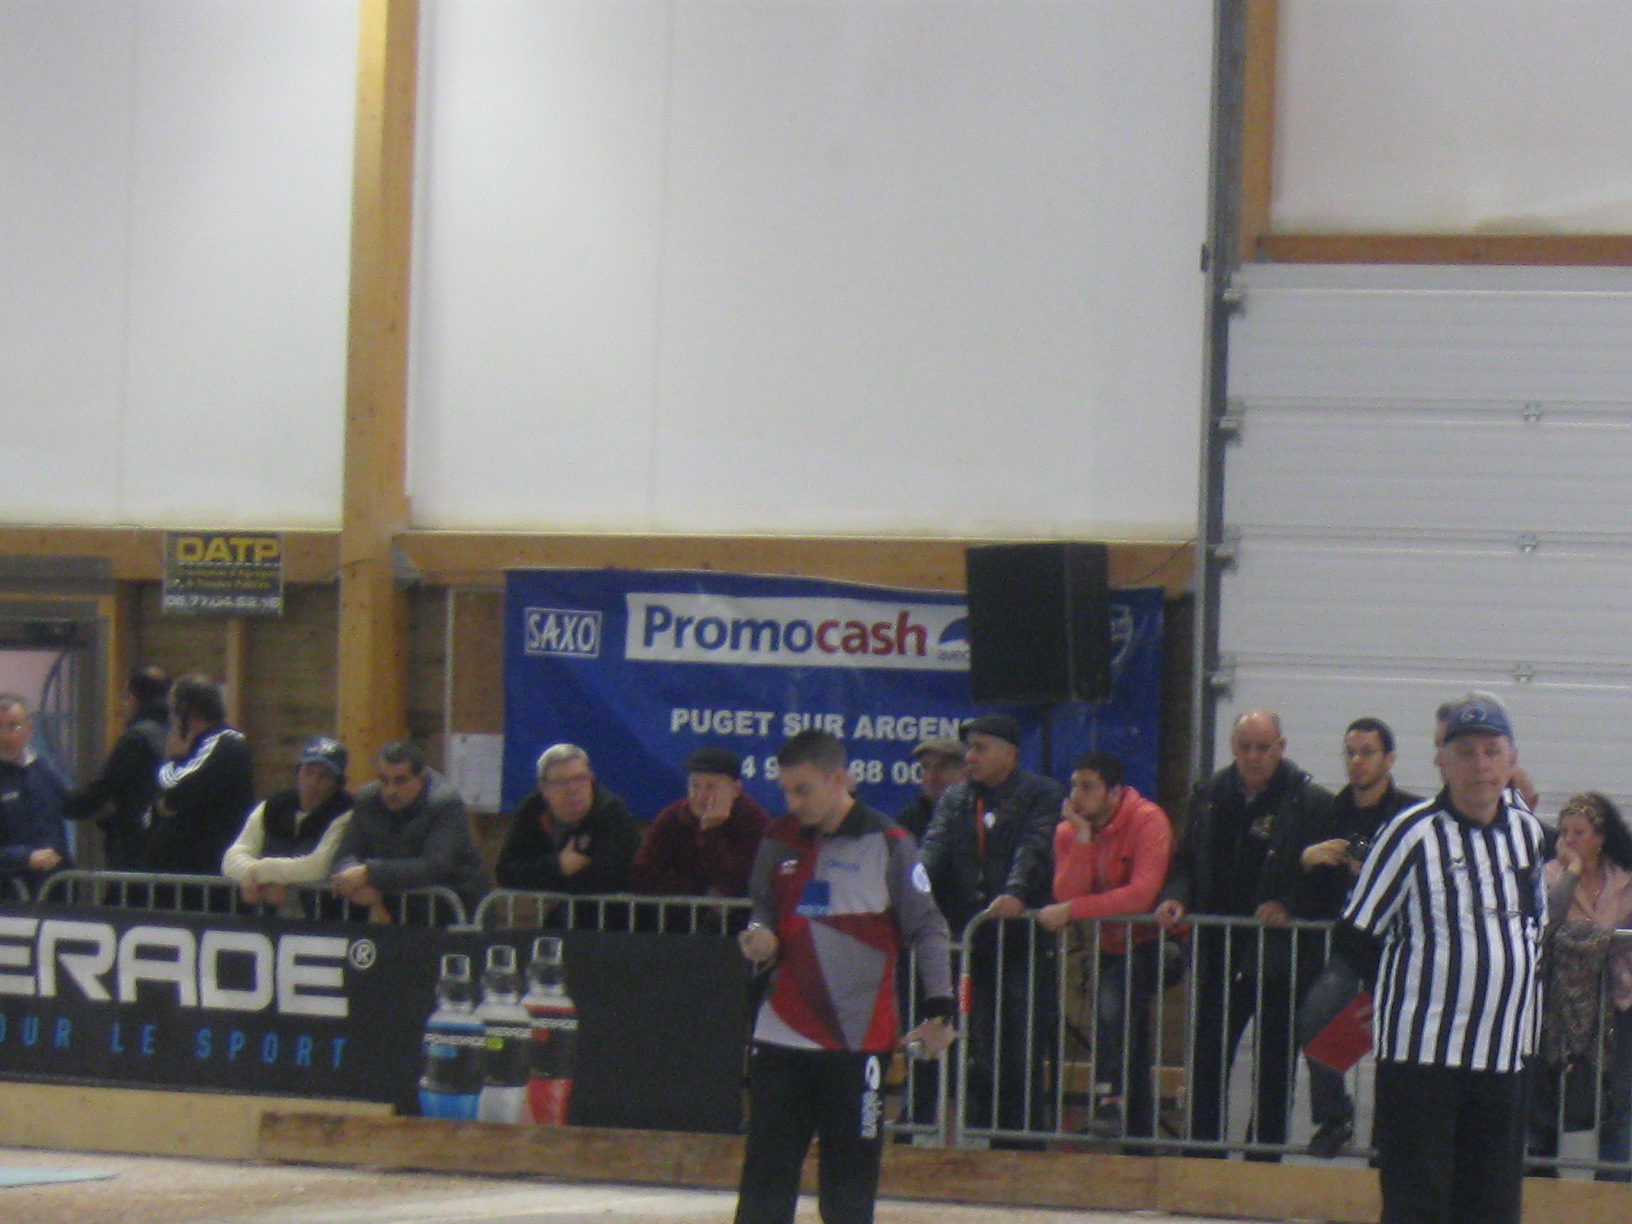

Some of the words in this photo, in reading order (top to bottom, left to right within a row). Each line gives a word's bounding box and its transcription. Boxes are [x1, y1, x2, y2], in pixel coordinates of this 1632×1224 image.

[526, 611, 598, 652] SAXO
[643, 603, 928, 657] Promocash
[670, 707, 775, 736] PUGET
[111, 1022, 156, 1055] LE
[195, 1027, 346, 1069] SPORT
